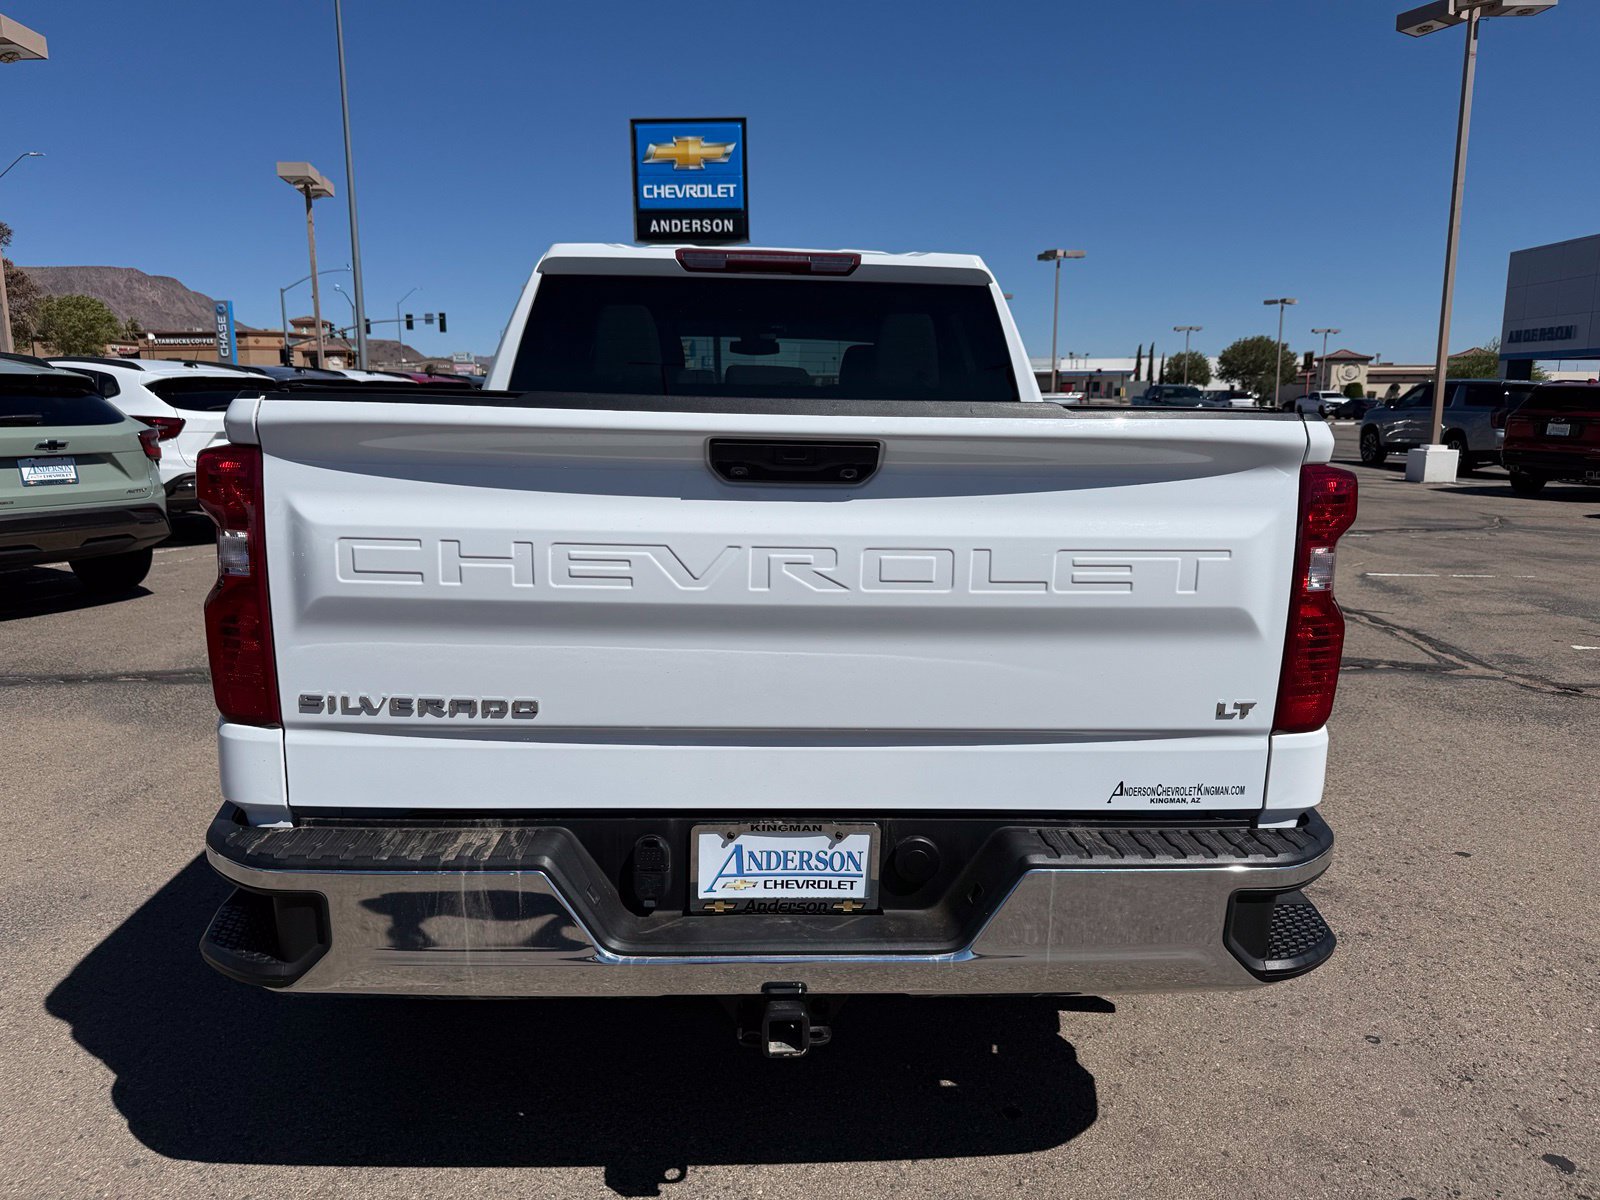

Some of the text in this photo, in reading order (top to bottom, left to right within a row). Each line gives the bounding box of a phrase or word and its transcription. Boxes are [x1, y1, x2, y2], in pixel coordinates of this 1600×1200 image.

[643, 184, 736, 198] CHEVROLET
[650, 219, 734, 233] ANDERSON
[154, 338, 190, 346] STARBUCKS
[217, 316, 229, 357] CHASE
[1507, 325, 1577, 343] ANDERSON
[336, 536, 1232, 594] CHEVROLET
[298, 693, 539, 720] SILVERADO
[1215, 702, 1257, 720] LT
[1150, 797, 1189, 805] KINGMAN,
[750, 824, 823, 832] KINGMAN
[703, 844, 864, 893] ANDERSON
[763, 879, 858, 891] CHEVROLET
[743, 899, 829, 915] Anderson
